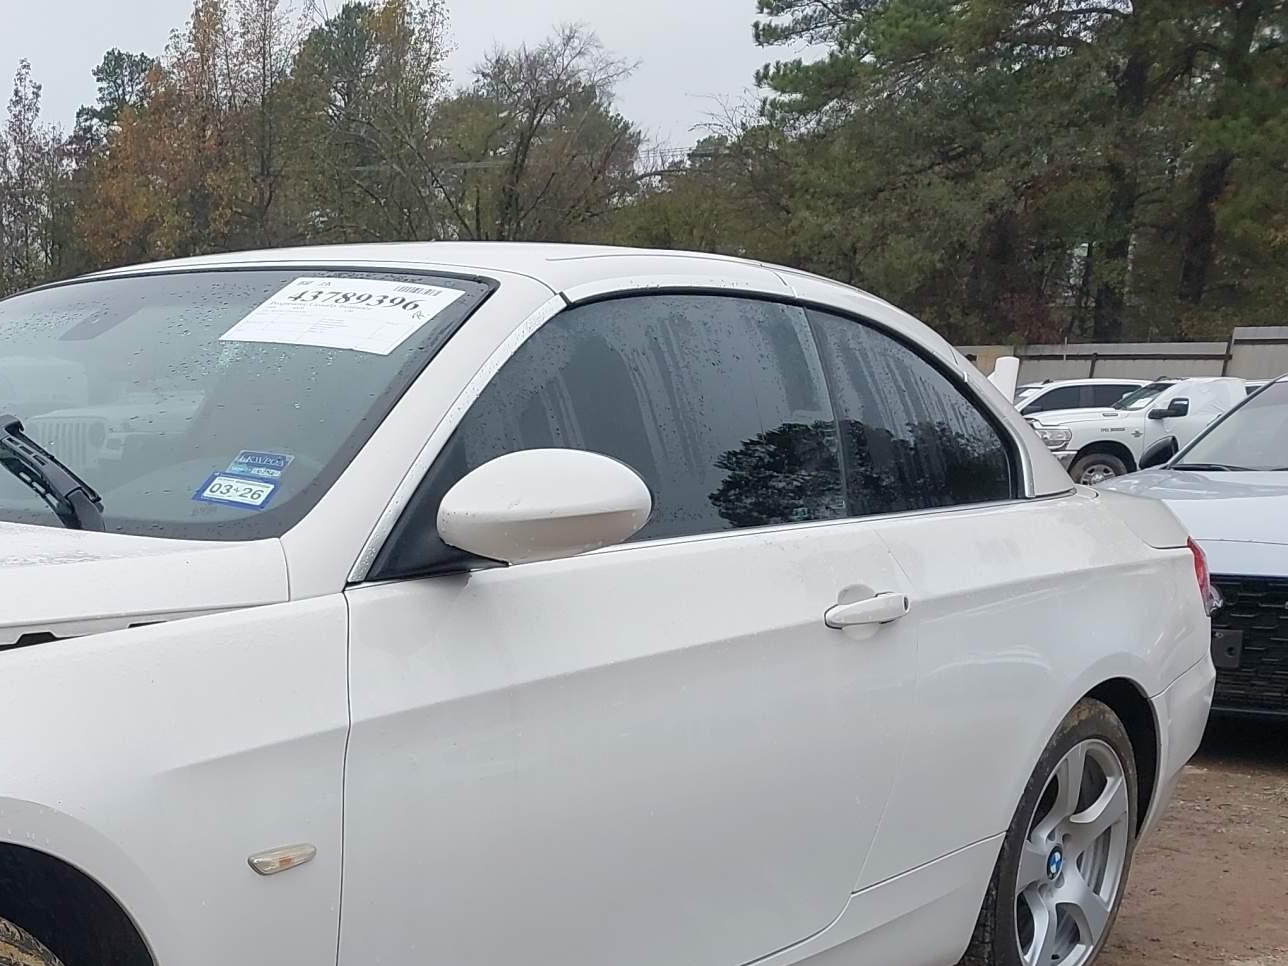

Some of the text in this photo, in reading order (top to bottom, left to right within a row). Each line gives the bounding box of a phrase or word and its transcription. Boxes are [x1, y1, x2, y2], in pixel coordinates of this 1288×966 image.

[288, 288, 424, 311] 43789396
[209, 482, 233, 495] 03
[239, 487, 264, 500] 26
